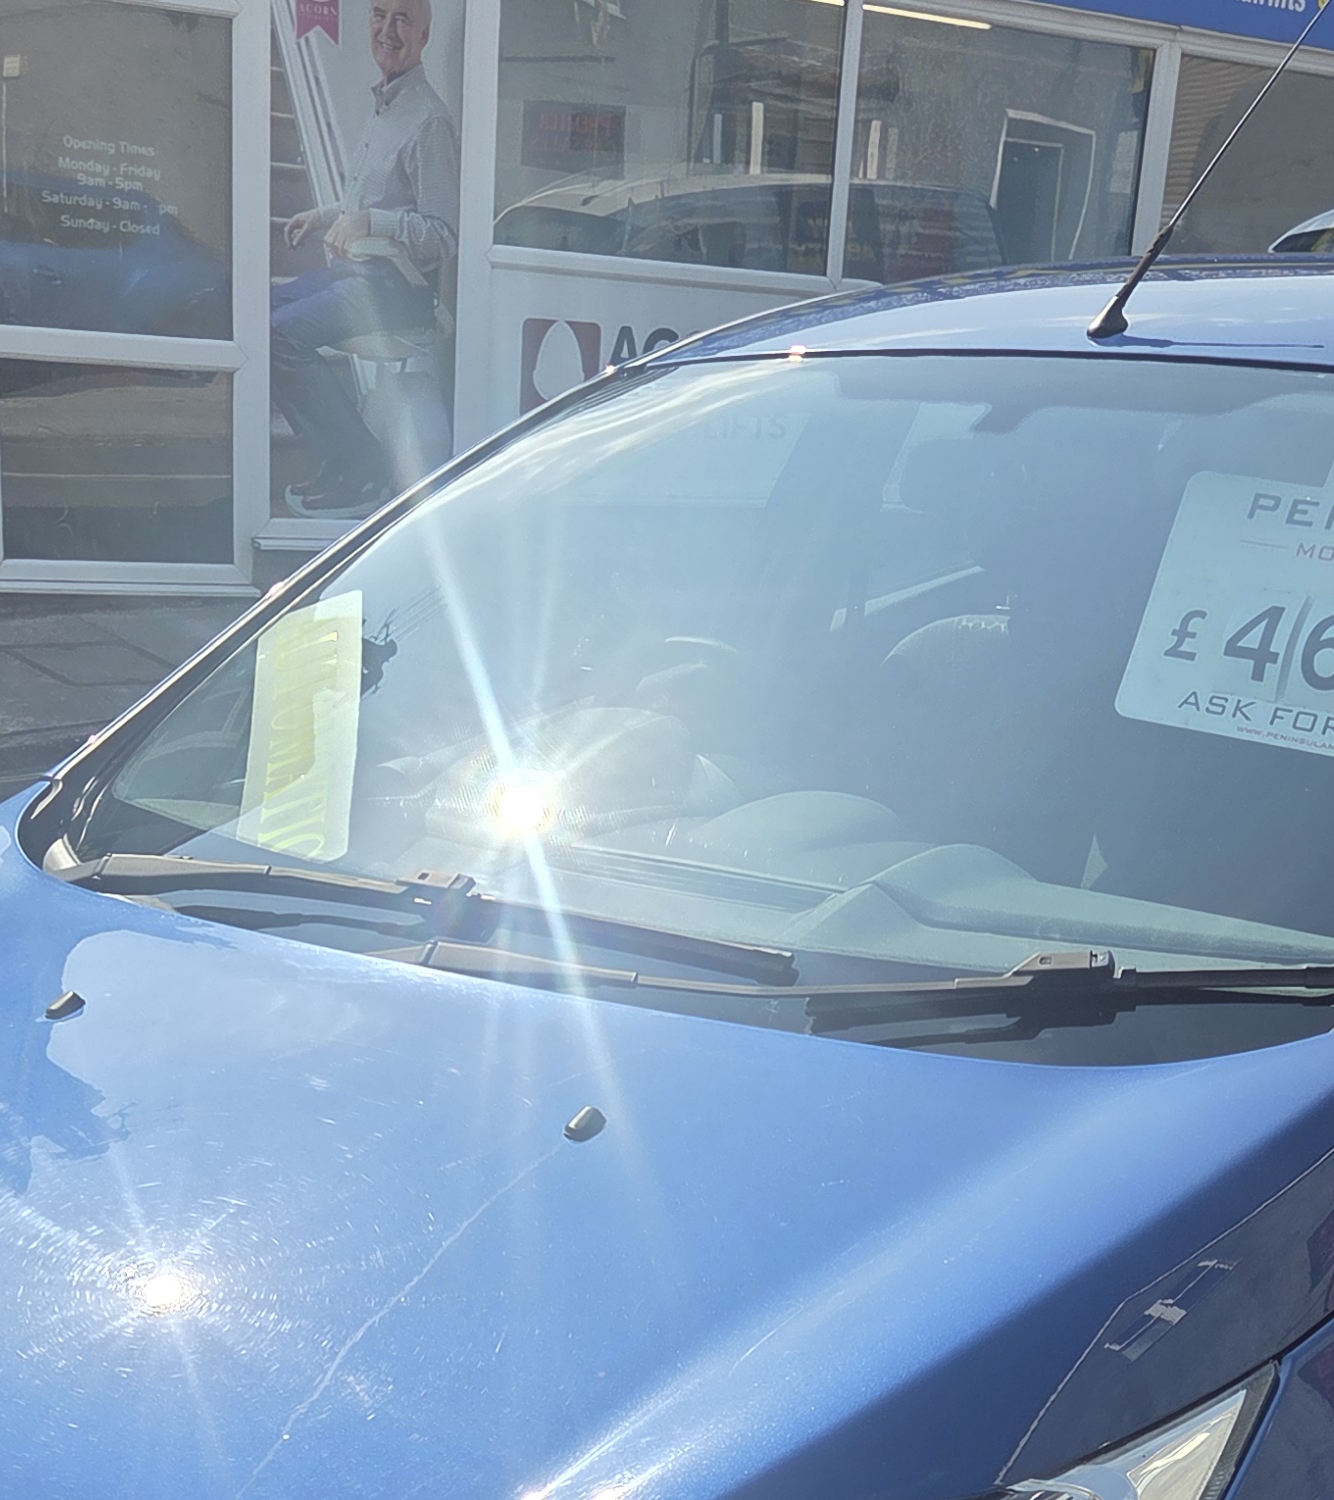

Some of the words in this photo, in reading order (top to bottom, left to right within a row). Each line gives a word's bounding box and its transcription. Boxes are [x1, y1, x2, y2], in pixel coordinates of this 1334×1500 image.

[62, 135, 116, 155] Opening
[118, 140, 156, 156] Times
[58, 157, 110, 176] Monday
[120, 162, 161, 181] Friday
[76, 173, 106, 187] 9am
[115, 177, 143, 192] 5pm
[41, 190, 103, 209] Saturday
[112, 197, 141, 211] 9am
[61, 214, 110, 233] Sunday
[119, 220, 161, 236] Closed
[1177, 690, 1258, 722] ASK
